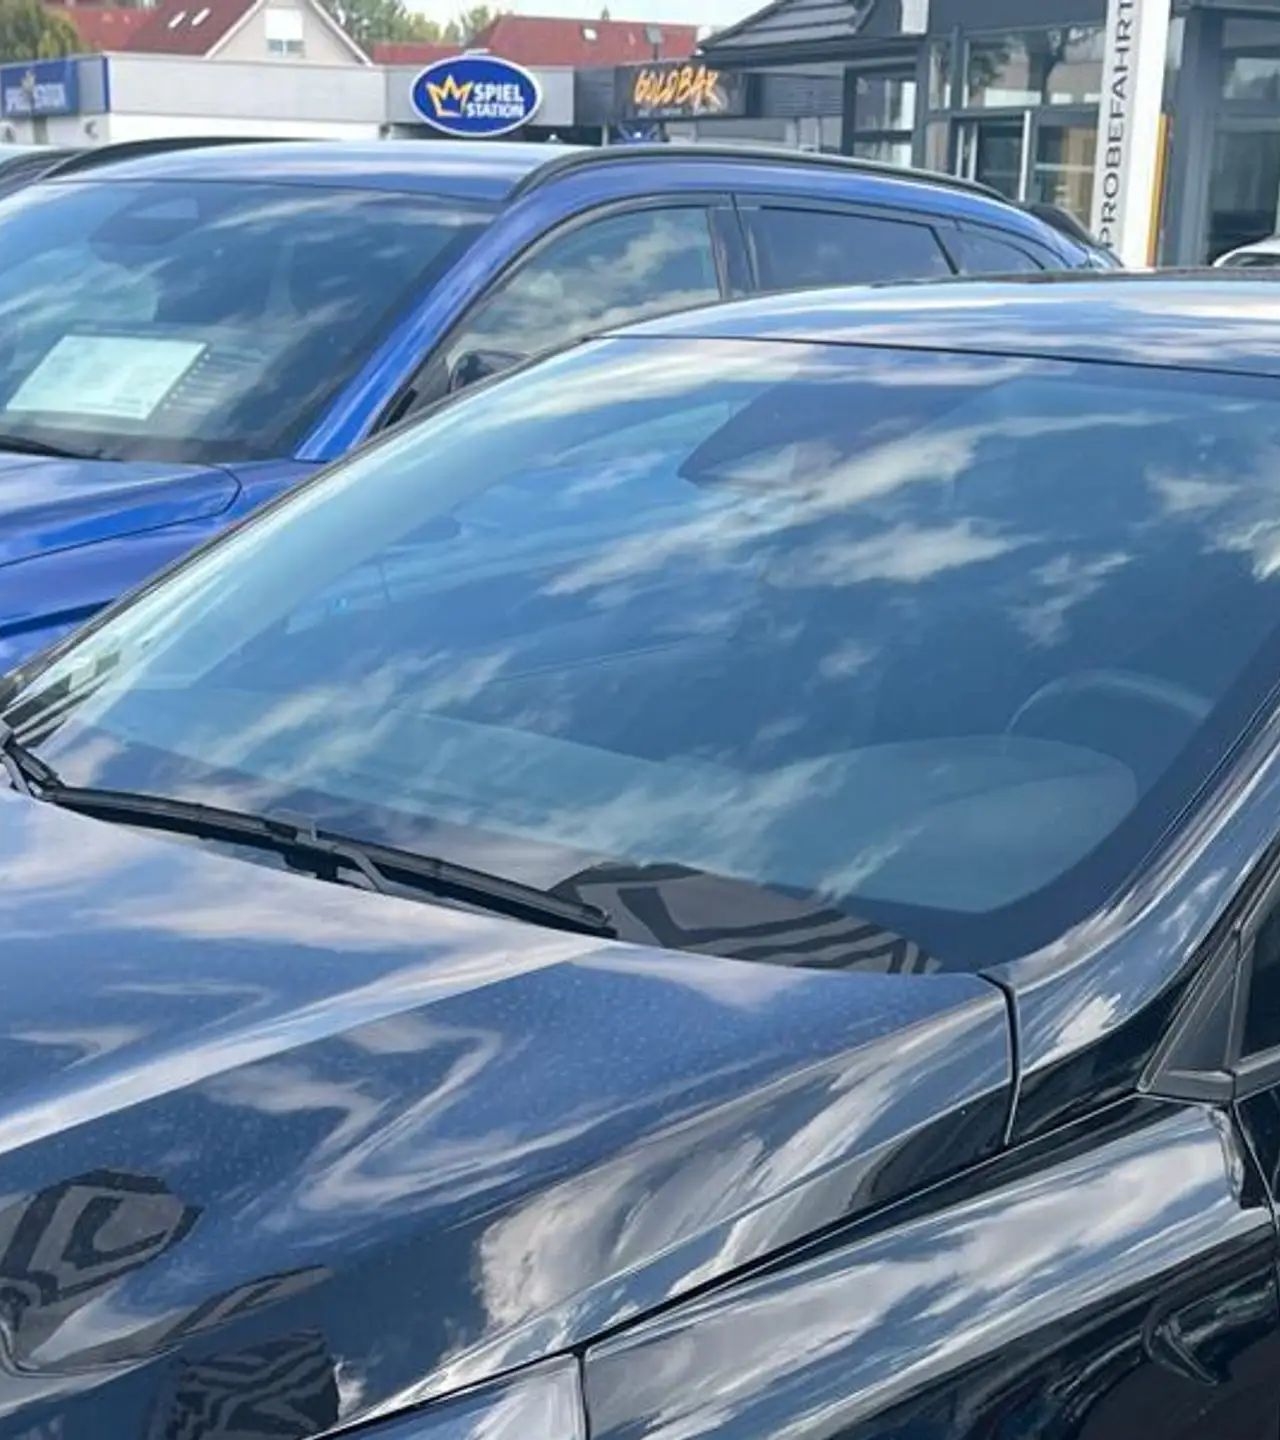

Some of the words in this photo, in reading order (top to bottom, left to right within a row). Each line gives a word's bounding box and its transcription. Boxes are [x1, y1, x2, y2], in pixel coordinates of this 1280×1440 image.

[474, 82, 524, 103] SPIEL
[466, 102, 525, 118] STATION
[1099, 0, 1134, 249] PROBEFAHRT
